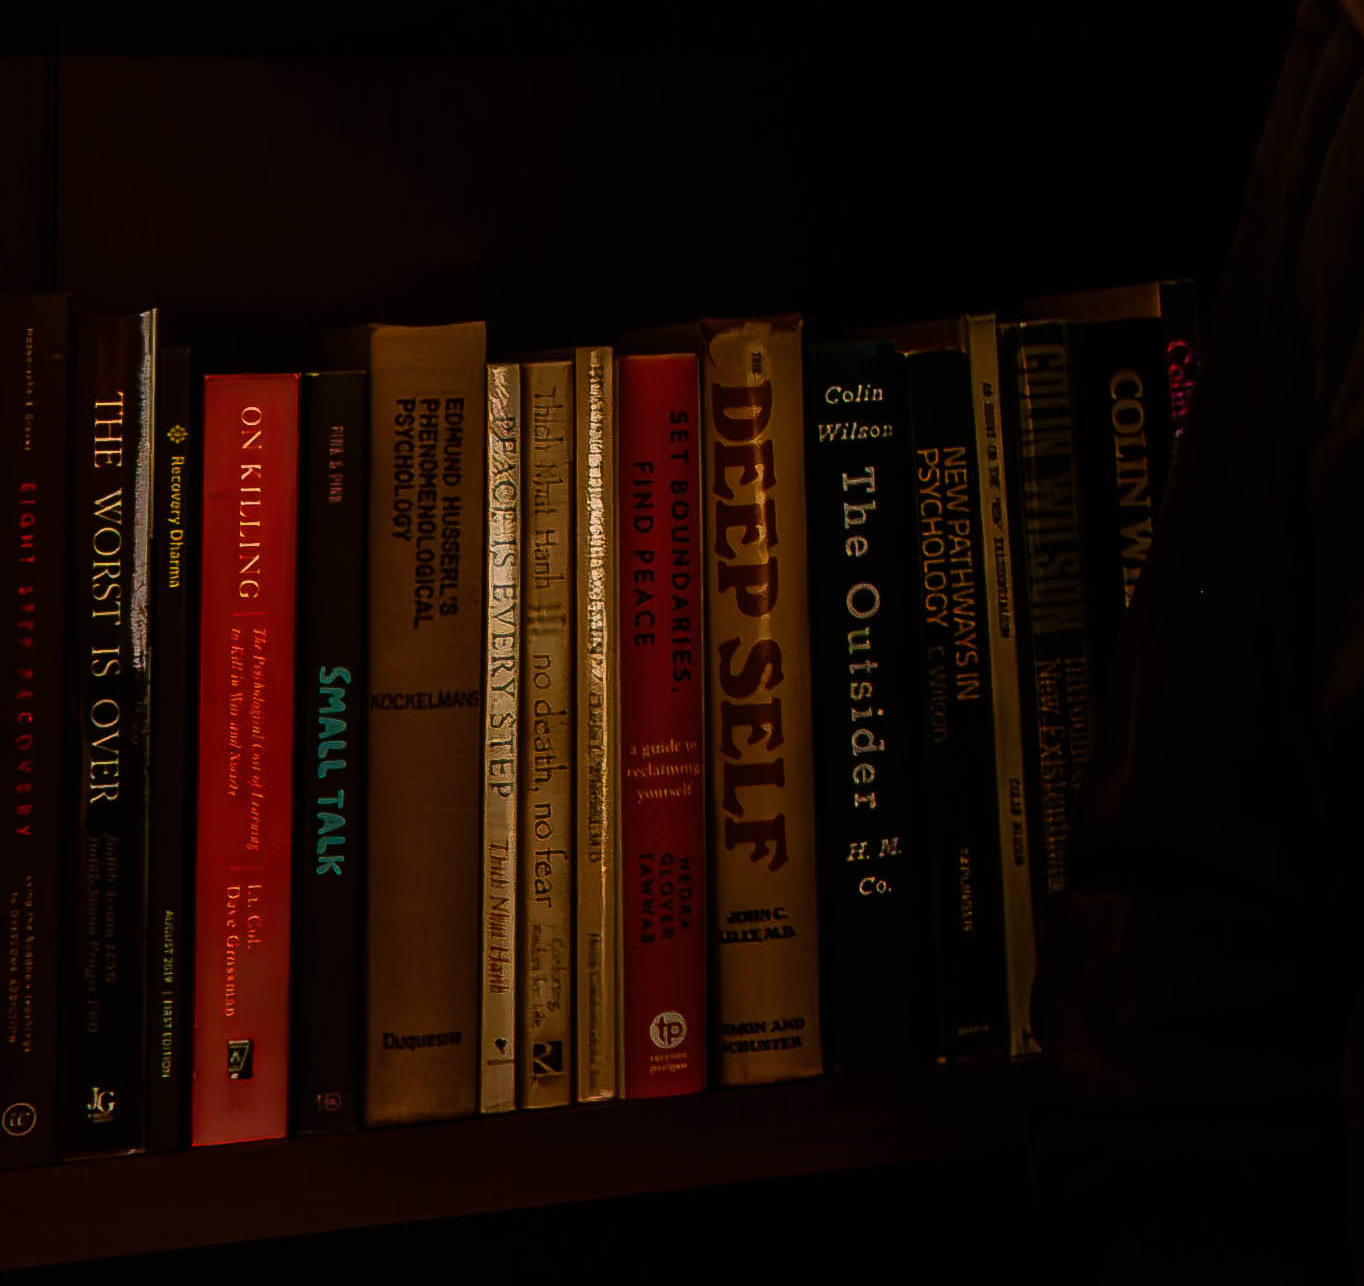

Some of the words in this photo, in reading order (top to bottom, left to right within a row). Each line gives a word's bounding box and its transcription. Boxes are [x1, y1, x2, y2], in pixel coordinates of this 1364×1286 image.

[92, 391, 125, 468] THE
[240, 405, 263, 450] ON
[532, 387, 564, 452] Thich
[670, 411, 689, 464] SET
[816, 421, 897, 445] Wilson
[823, 383, 884, 409] Colin
[1109, 366, 1153, 510] COLIN
[391, 397, 416, 543] PSYCHOLOGY
[443, 397, 464, 487] EDMUND
[489, 416, 518, 518] PEACE
[943, 444, 967, 512] NEW
[167, 455, 186, 526] Recovery
[238, 463, 263, 601] KILLING
[414, 397, 441, 630] PHENOMENOLOGICAL
[534, 462, 564, 516] Nhat
[634, 461, 654, 535] FIND
[711, 380, 780, 618] DEEP
[840, 465, 880, 560] The
[90, 487, 125, 628] WORST
[168, 529, 186, 589] Dharma
[440, 495, 462, 616] HUSSERL'S
[491, 524, 518, 568] IS
[533, 529, 564, 591] Hanh
[914, 447, 950, 629] PSYCHOLOGY
[634, 549, 656, 648] PEACE
[669, 480, 693, 694] BOUNDARIES,
[944, 511, 980, 669] PATHWAYS
[89, 645, 121, 678] IS
[490, 584, 519, 705] EVERY
[532, 654, 553, 690] no
[956, 673, 980, 702] IN
[316, 664, 353, 780] SMALL
[845, 581, 888, 813] Outsider
[87, 698, 121, 805] OVER
[487, 712, 517, 799] STEP
[531, 699, 568, 792] death,
[717, 636, 790, 872] SELF
[314, 789, 346, 877] TALK
[533, 801, 552, 840] no
[636, 782, 693, 805] yourself
[533, 849, 569, 909] fear
[845, 840, 872, 864] H.
[878, 835, 904, 858] M.
[857, 875, 895, 900] Co.
[224, 884, 241, 927] Dave
[224, 932, 241, 1019] Grossman
